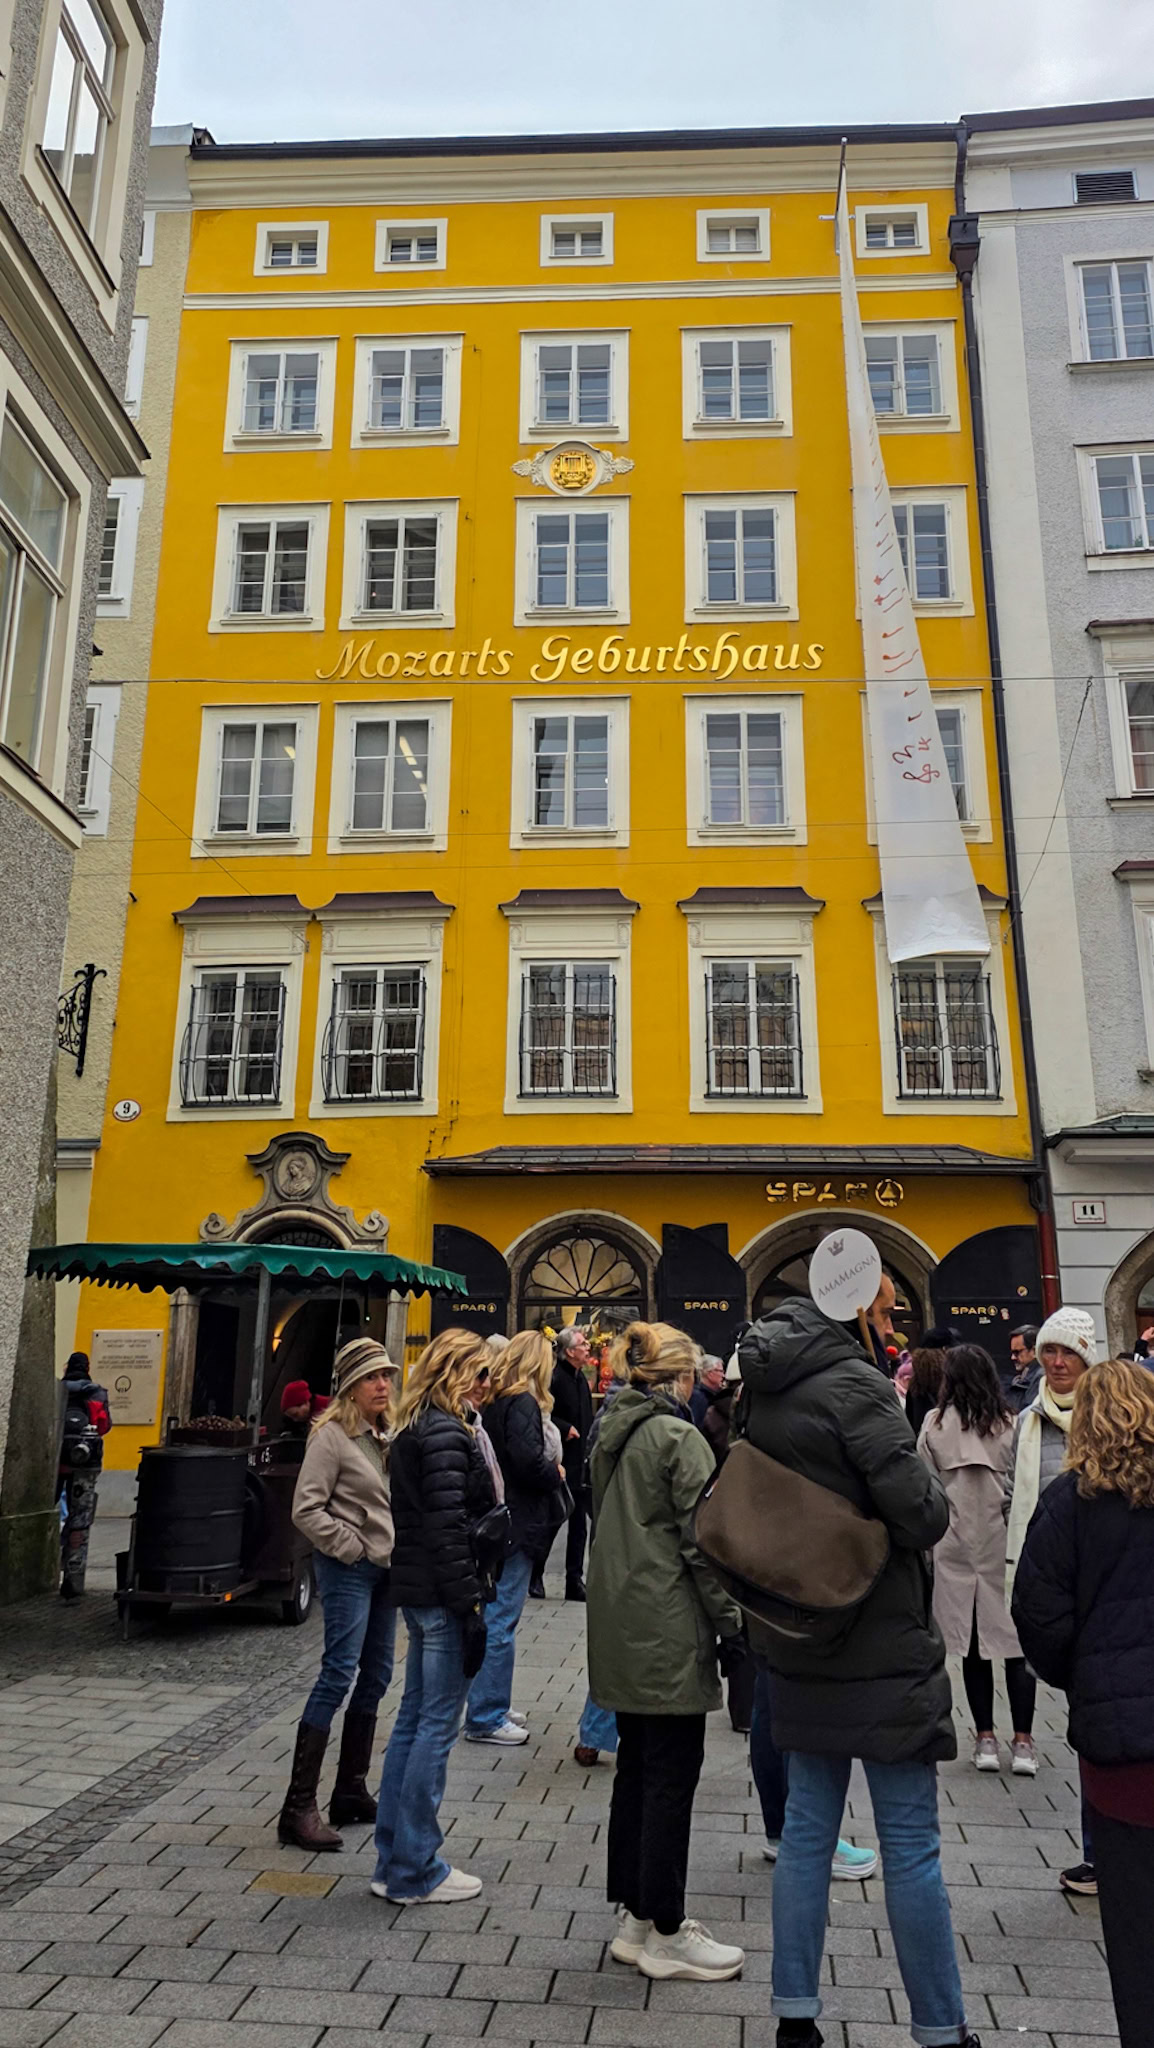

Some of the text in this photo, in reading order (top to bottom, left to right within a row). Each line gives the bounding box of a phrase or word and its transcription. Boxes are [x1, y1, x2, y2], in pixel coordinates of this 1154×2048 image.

[315, 631, 825, 682] Mozarts Geburtshaus
[124, 1102, 131, 1114] 9
[766, 1182, 869, 1202] SPAR
[1082, 1204, 1095, 1216] 11
[451, 1303, 486, 1312] SPAR
[684, 1301, 719, 1310] SPAR
[951, 1306, 987, 1315] SPAR
